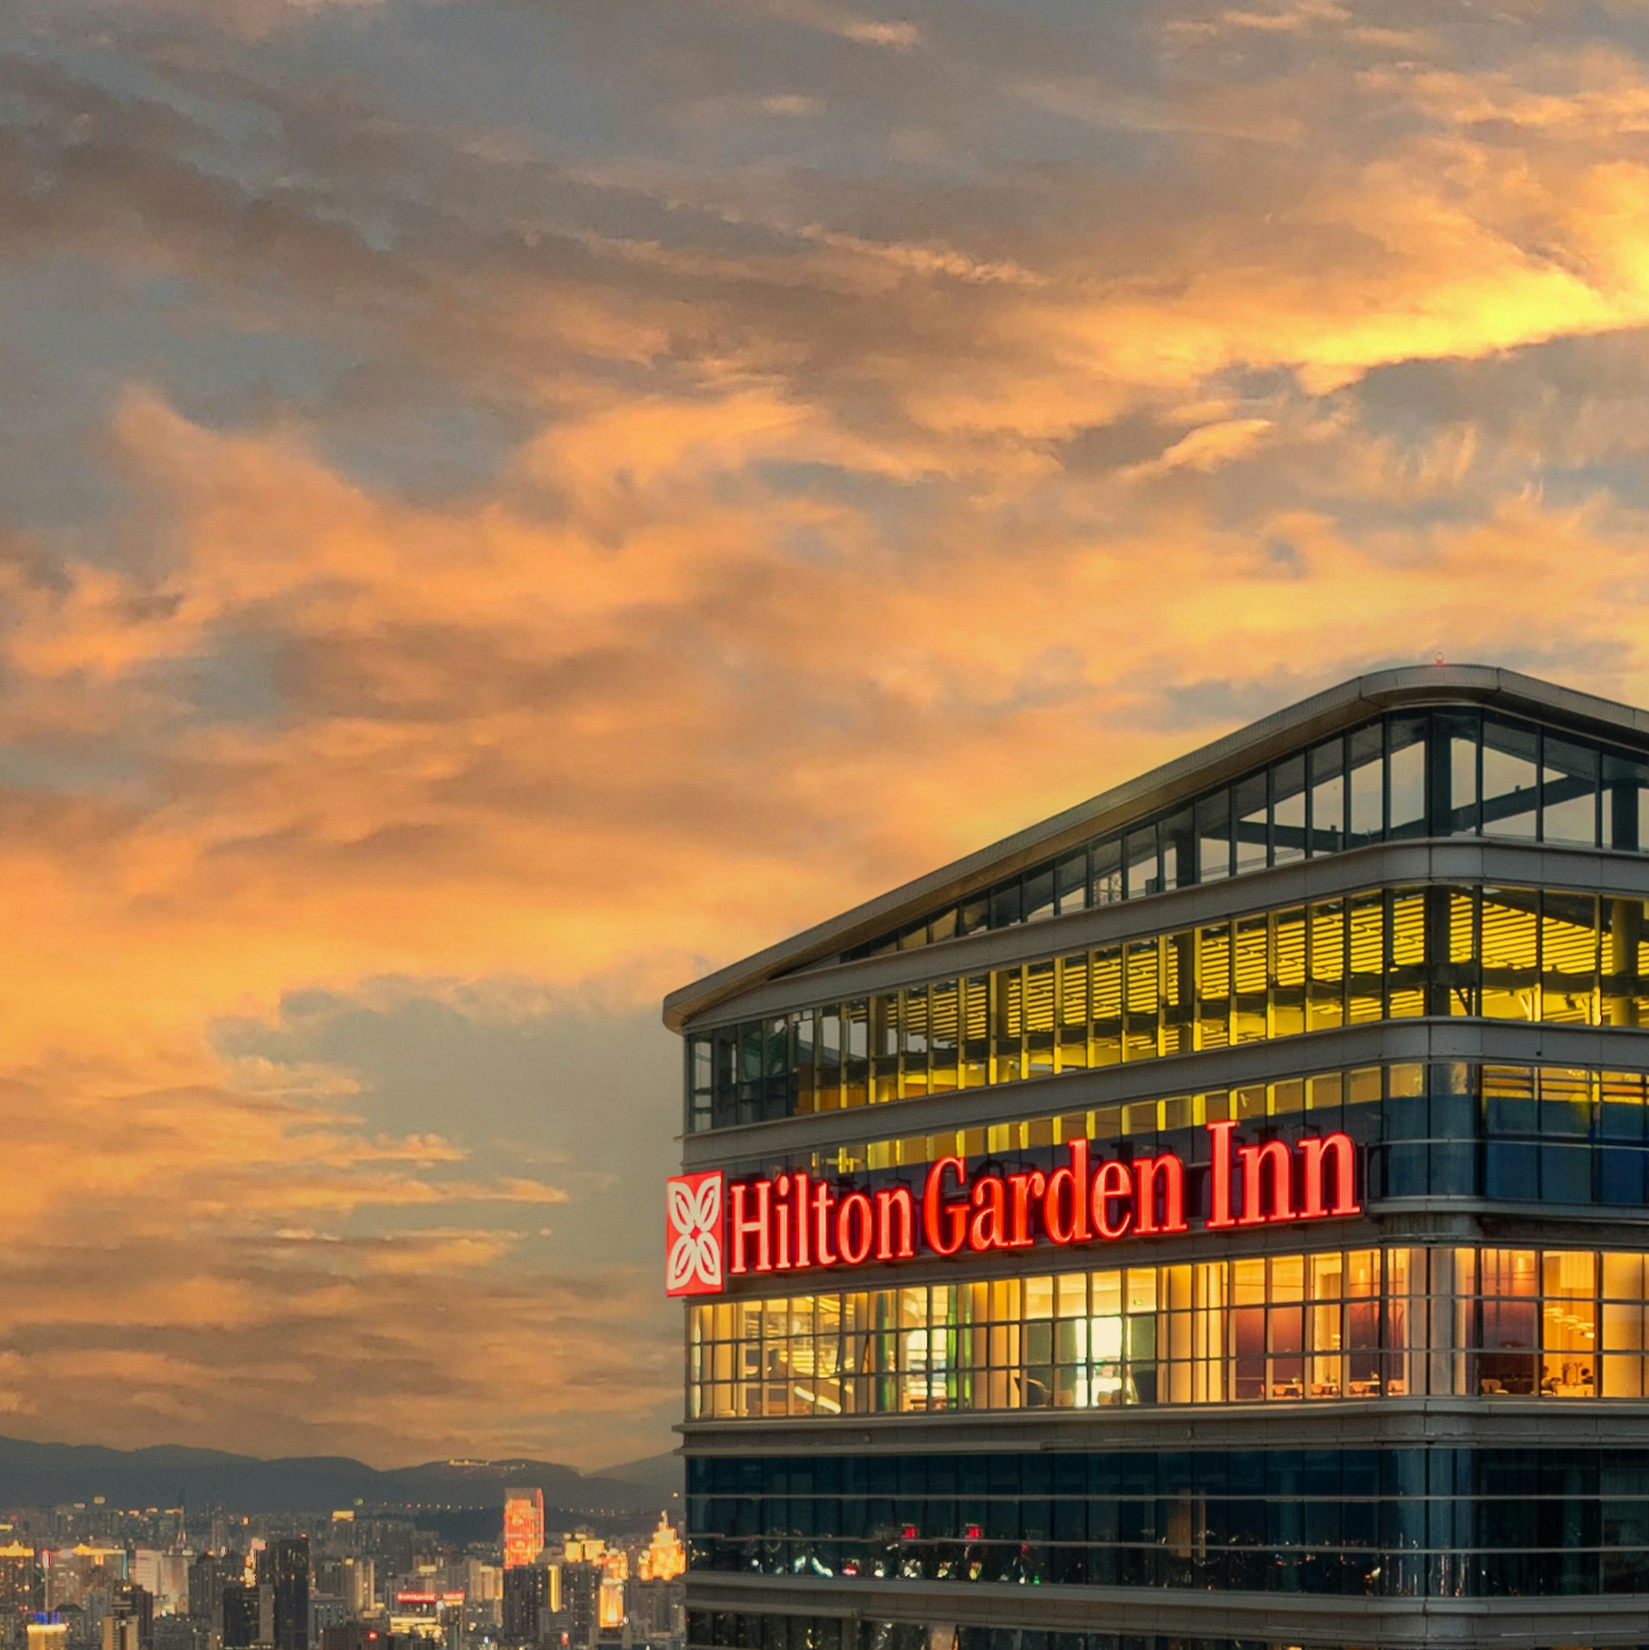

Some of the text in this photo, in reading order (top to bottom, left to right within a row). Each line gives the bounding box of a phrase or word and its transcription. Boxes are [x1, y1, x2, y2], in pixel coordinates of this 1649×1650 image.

[730, 1119, 1361, 1274] Hilton Garden Inn
